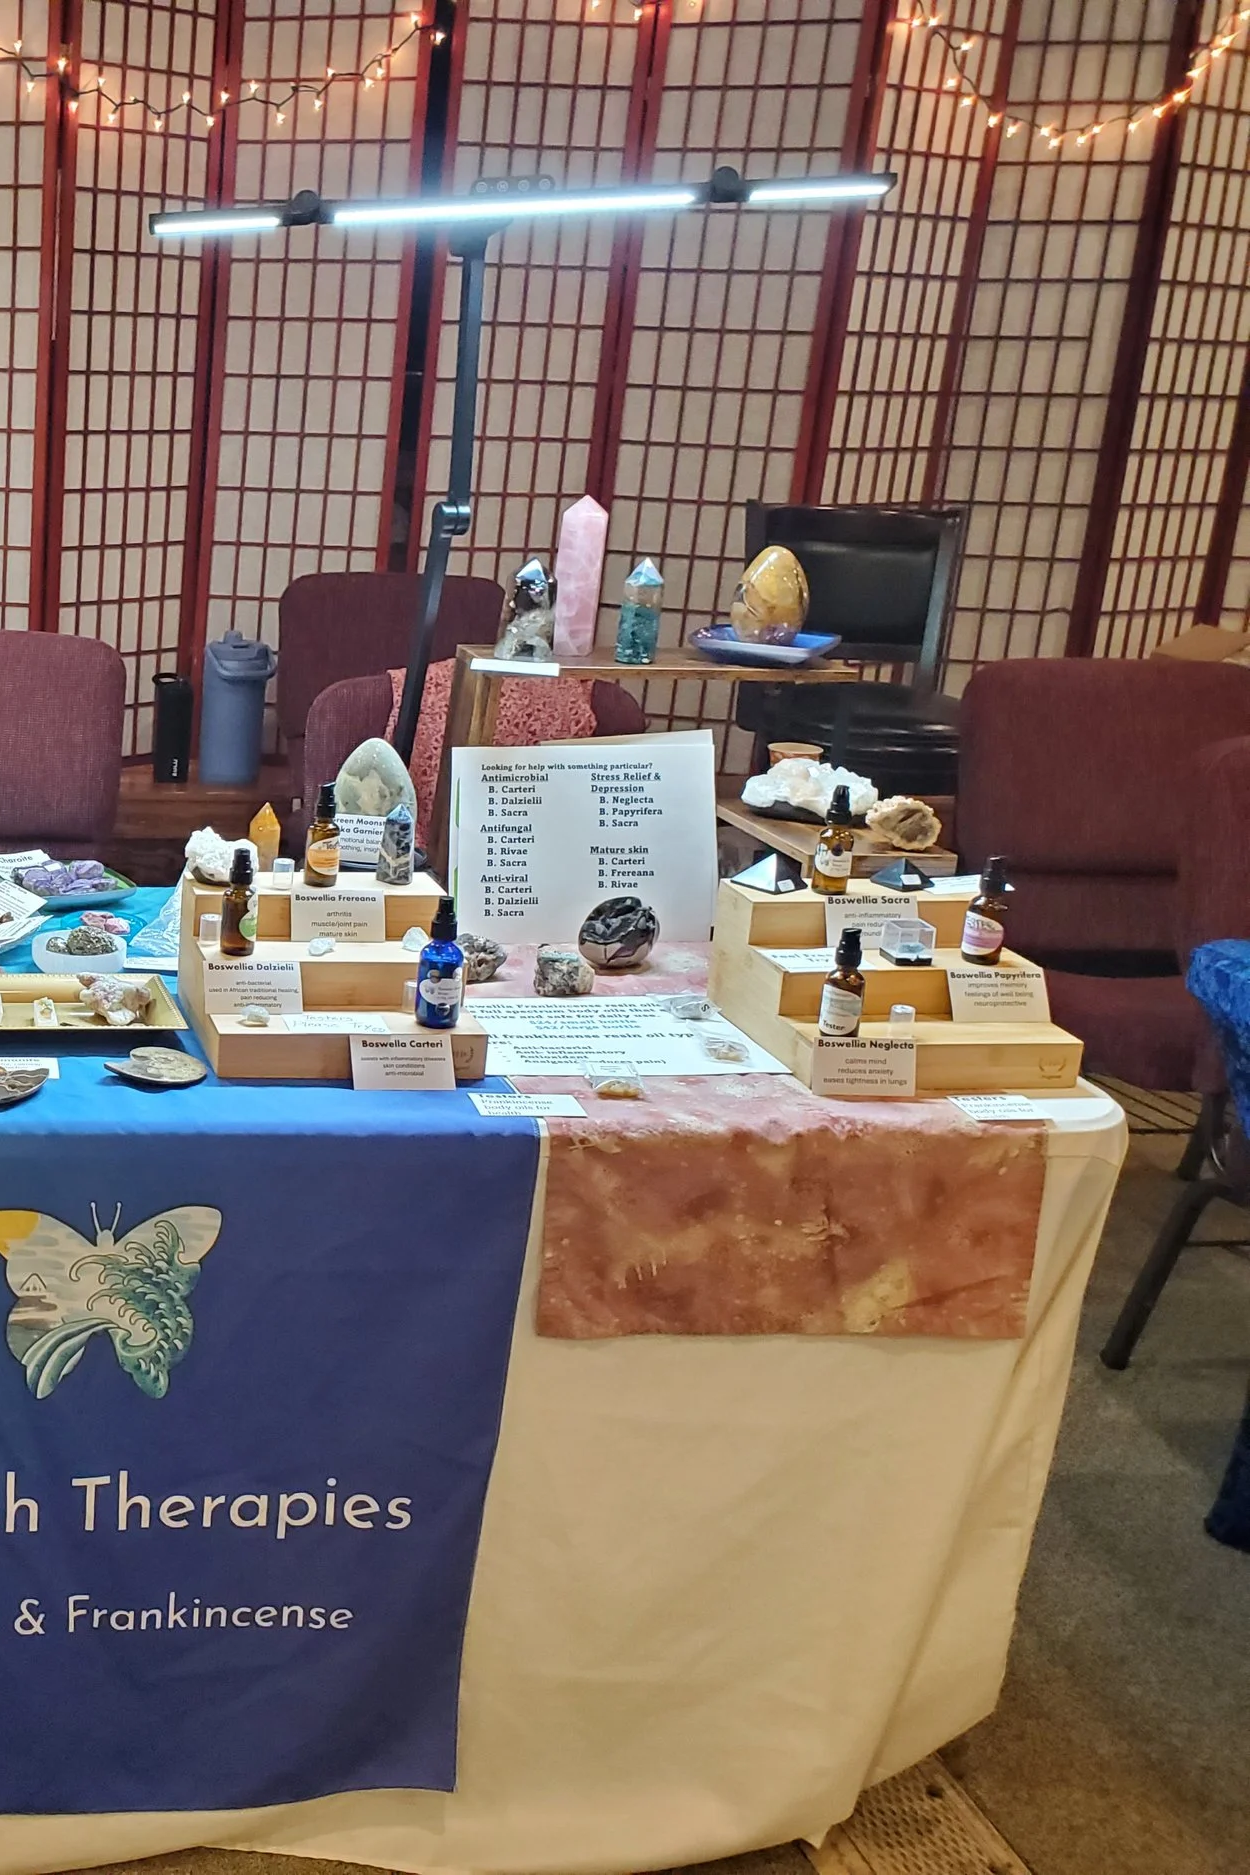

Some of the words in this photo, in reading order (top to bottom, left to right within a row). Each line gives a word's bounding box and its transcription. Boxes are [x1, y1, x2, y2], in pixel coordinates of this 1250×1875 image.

[481, 764, 513, 772] Looking
[528, 763, 545, 771] help
[568, 762, 608, 771] something
[610, 762, 653, 771] particular?
[481, 773, 549, 782] Antimicrobial
[591, 773, 620, 781] Stress
[623, 772, 651, 781] Relief
[653, 773, 661, 781] &
[488, 785, 498, 793] B.
[502, 785, 536, 793] Carteri
[591, 784, 644, 794] Depression
[488, 797, 498, 805] B.
[501, 797, 542, 805] Dalzielii
[599, 796, 609, 804] B.
[612, 796, 654, 805] Neglecta
[488, 809, 498, 817] B.
[599, 808, 609, 816] B.
[612, 807, 663, 818] Papyrifera
[612, 819, 639, 827] Sacra
[480, 824, 532, 834] Antifungal
[487, 836, 497, 844] B.
[500, 836, 535, 844] Carteri
[487, 848, 497, 856] B.
[500, 848, 528, 856] Rivae
[590, 846, 625, 854] Mature
[628, 845, 649, 854] skin
[500, 859, 527, 867] Sacra
[598, 858, 608, 866] B.
[611, 857, 645, 865] Carteri
[598, 869, 608, 877] B.
[611, 869, 655, 877] Frereana
[480, 874, 528, 883] Anti-viral
[485, 886, 495, 894] B.
[498, 885, 532, 894] Carteri
[598, 881, 608, 889] B.
[611, 881, 638, 889] Rivae
[295, 894, 336, 902] Boswellia
[484, 898, 494, 906] B.
[497, 897, 539, 906] Dalzielii
[828, 896, 878, 905] Boswellia
[881, 896, 910, 904] Sacra
[484, 909, 494, 917] B.
[497, 909, 524, 917] Sacra
[311, 920, 352, 928] muscle/joint
[208, 962, 254, 971] Boswellia
[256, 963, 294, 971] Dalzielii
[950, 971, 993, 979] Boswellia
[994, 971, 1042, 980] Papyrifera
[822, 1019, 846, 1031] Tester
[361, 1039, 407, 1049] Boswella
[409, 1039, 444, 1049] Carteri
[817, 1039, 867, 1049] Boswellia
[869, 1040, 914, 1051] Neglecta
[868, 1068, 894, 1076] anxiety
[71, 1469, 414, 1541] Therapies
[13, 1598, 47, 1636] &
[66, 1592, 354, 1636] Frankincense
